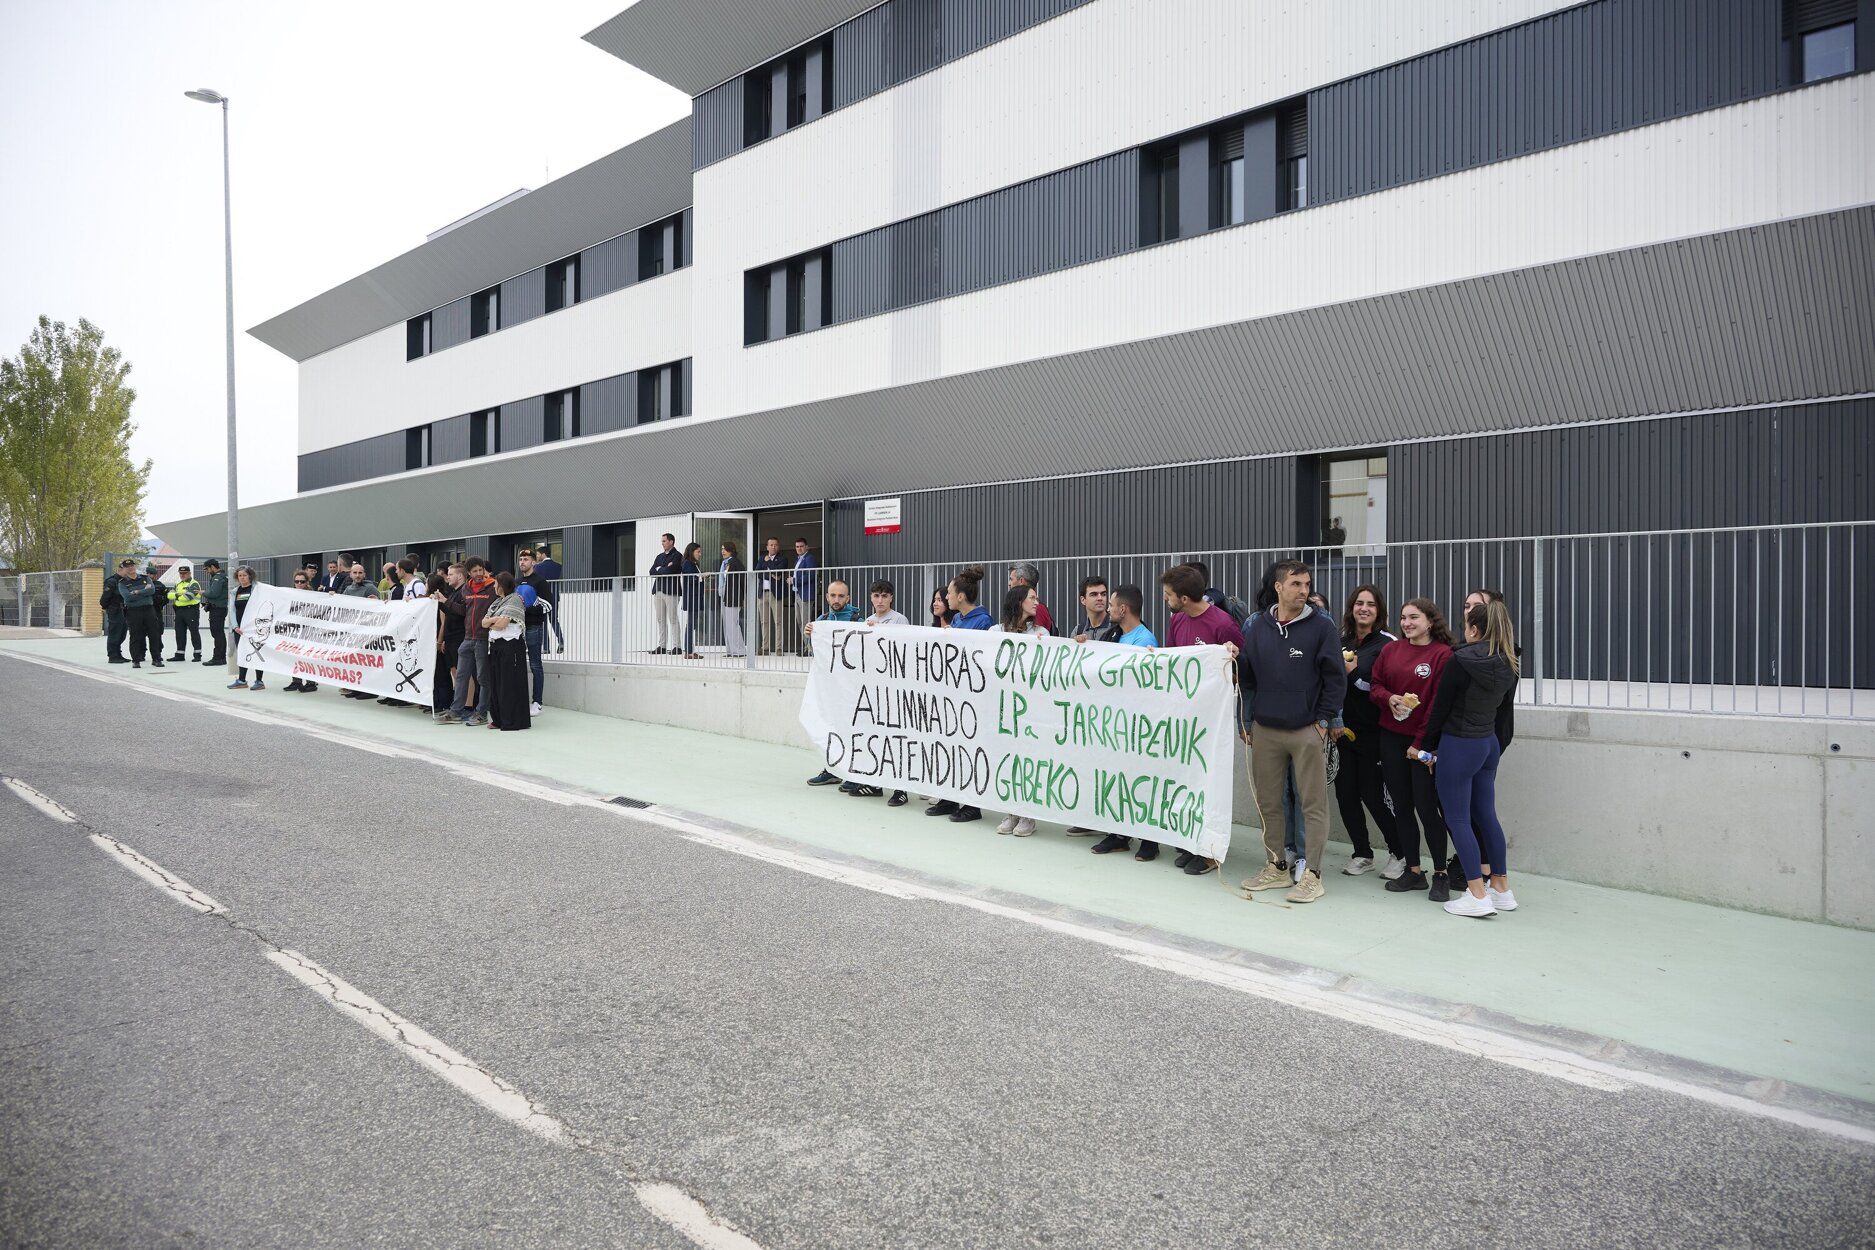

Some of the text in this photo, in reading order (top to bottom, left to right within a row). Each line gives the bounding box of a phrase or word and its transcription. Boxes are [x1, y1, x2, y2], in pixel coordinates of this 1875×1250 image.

[317, 664, 363, 685] HORAS?
[830, 628, 986, 693] FCT SIN HORAS
[994, 638, 1201, 699] ORDURIK GABEKO
[852, 684, 978, 740] ALUMNADO
[1053, 700, 1208, 773] JARRAIPENIK
[826, 732, 990, 796] DESATENDIDO
[995, 753, 1205, 843] GABEKO IKASLEGOA
